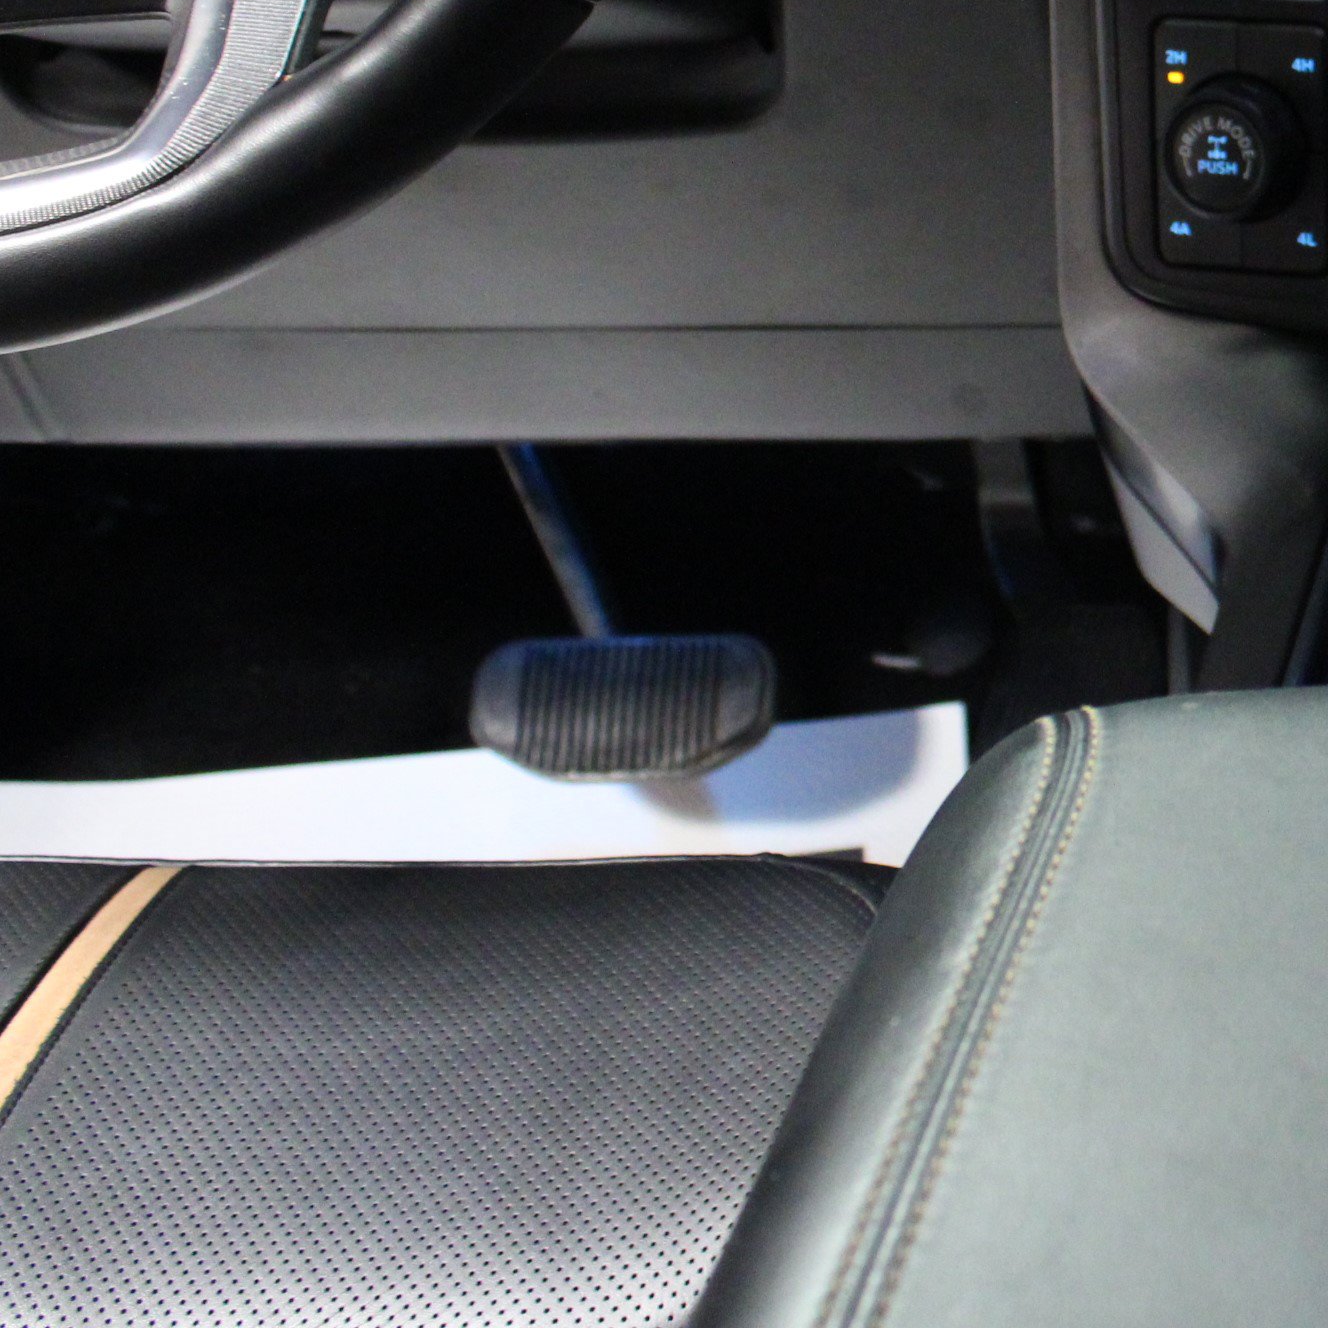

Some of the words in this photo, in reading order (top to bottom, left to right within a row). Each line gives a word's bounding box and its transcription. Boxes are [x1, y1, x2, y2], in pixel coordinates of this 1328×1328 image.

[1165, 49, 1188, 65] 2H
[1291, 58, 1317, 73] 4H
[1197, 159, 1239, 175] PUSH
